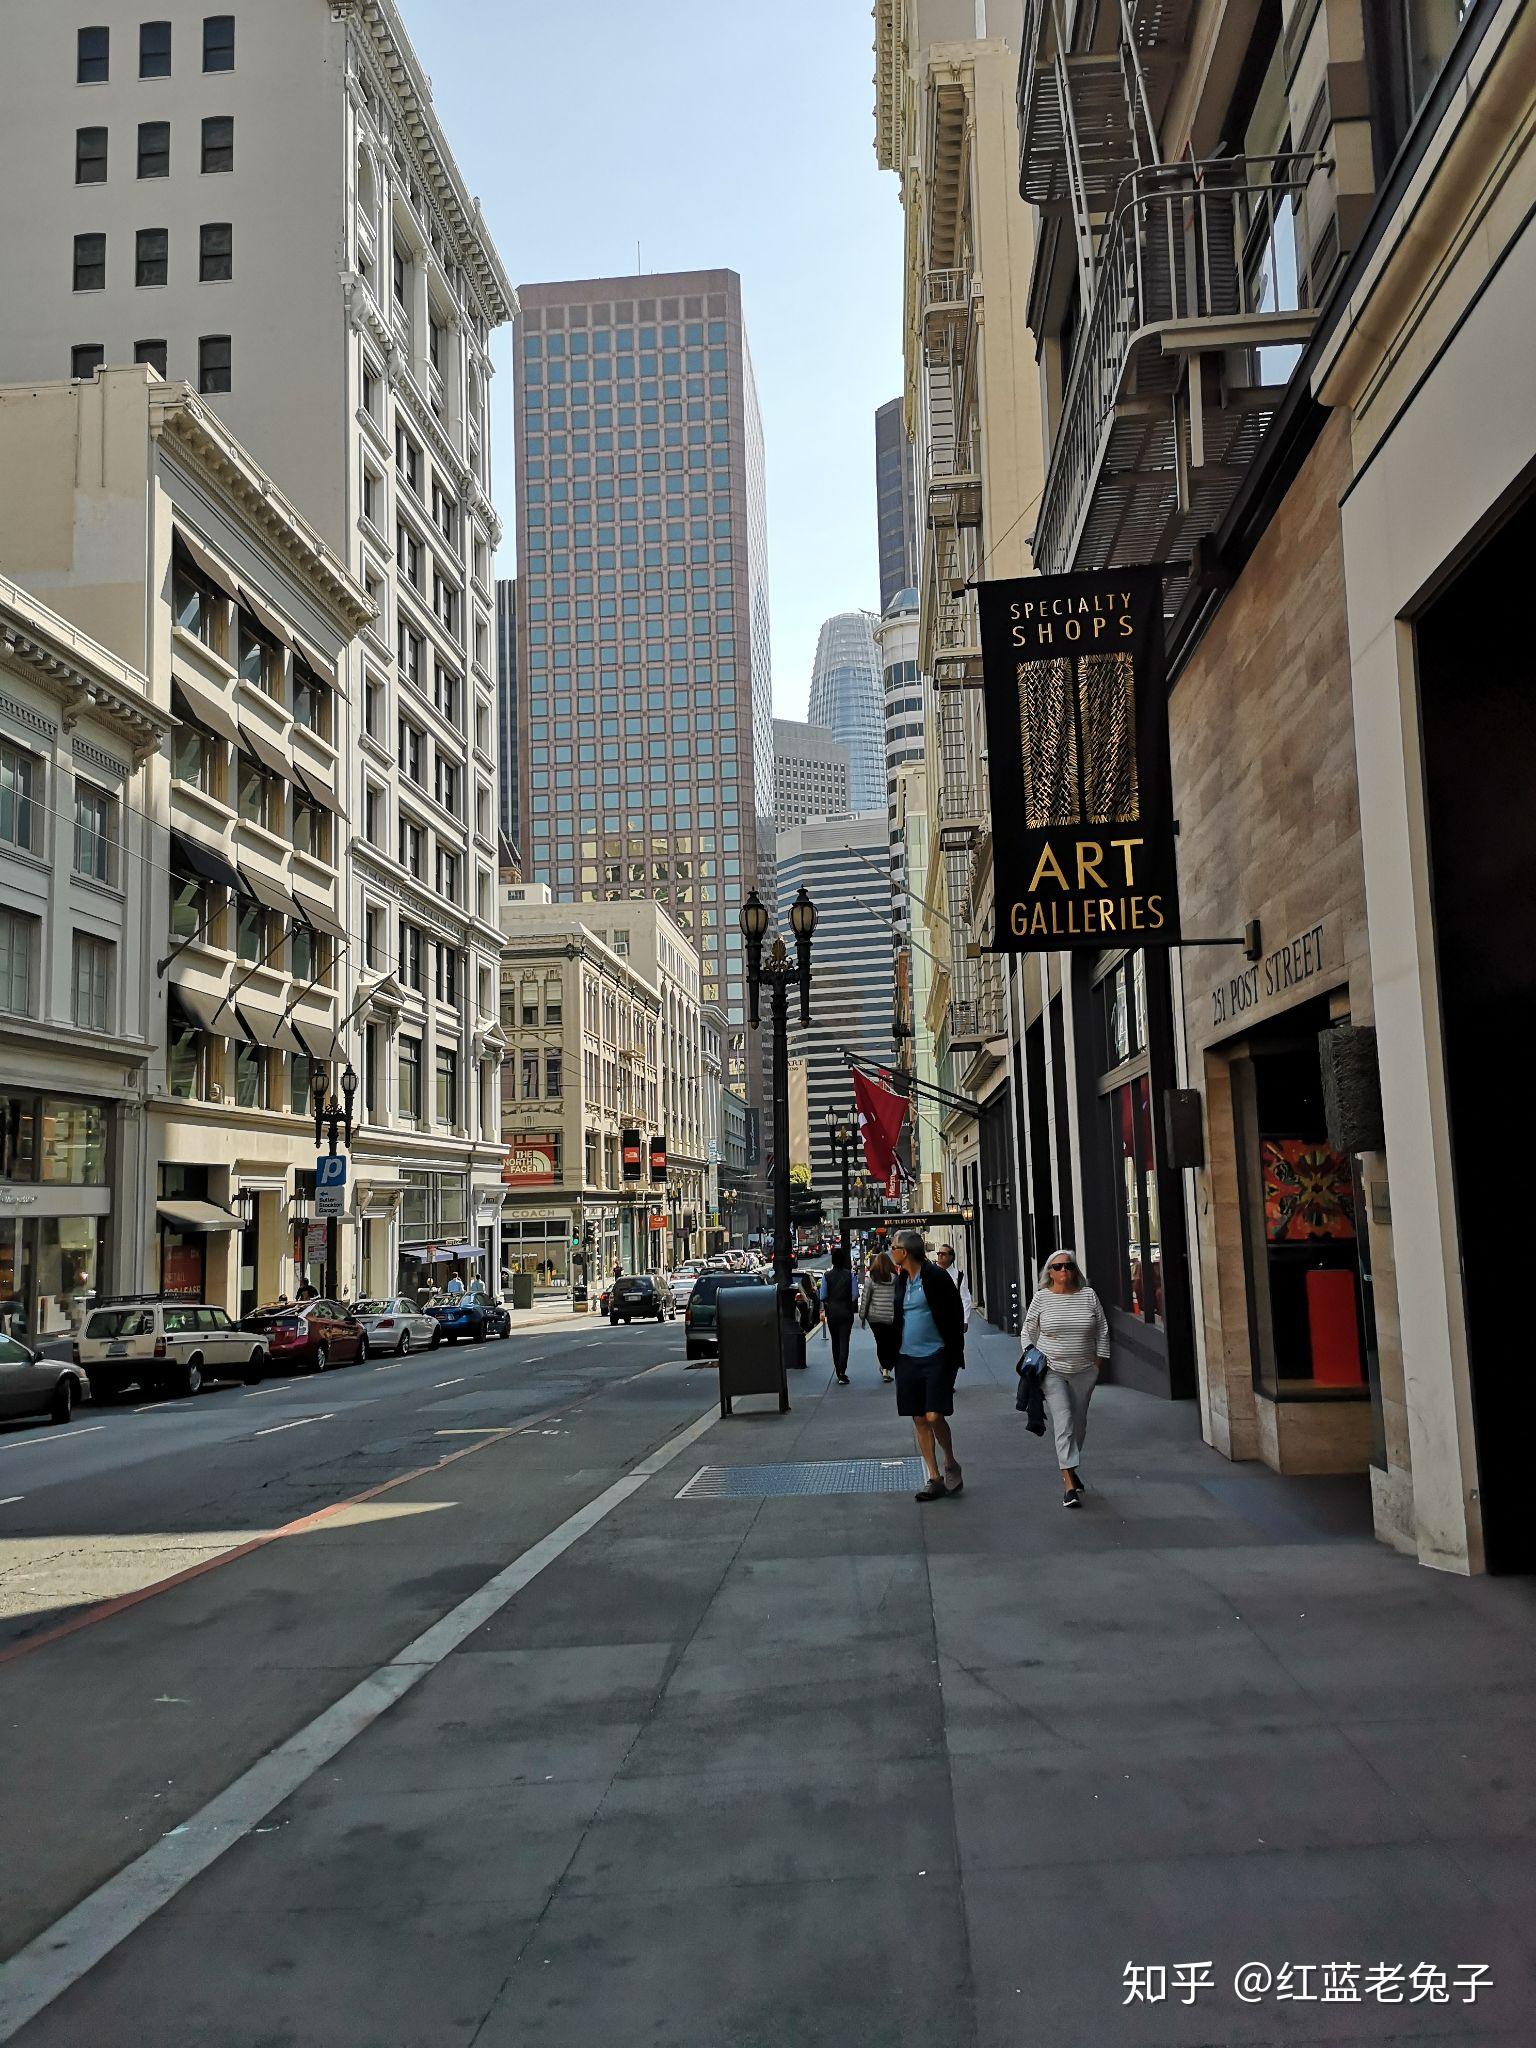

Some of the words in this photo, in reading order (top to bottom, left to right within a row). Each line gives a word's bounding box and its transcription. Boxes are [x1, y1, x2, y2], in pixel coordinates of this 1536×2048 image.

[1010, 592, 1132, 620] SPECIALTY
[1011, 614, 1134, 647] SHOPS
[1027, 838, 1144, 893] ART
[1010, 894, 1165, 936] GALLERIES
[1211, 986, 1226, 1027] 251
[1230, 964, 1259, 1016] POST
[1265, 924, 1324, 996] STREET
[502, 1158, 533, 1167] NORTH
[515, 1150, 533, 1158] THE
[510, 1166, 533, 1174] FACE
[511, 1209, 555, 1219] COACH
[883, 1218, 928, 1226] BURBERRY
